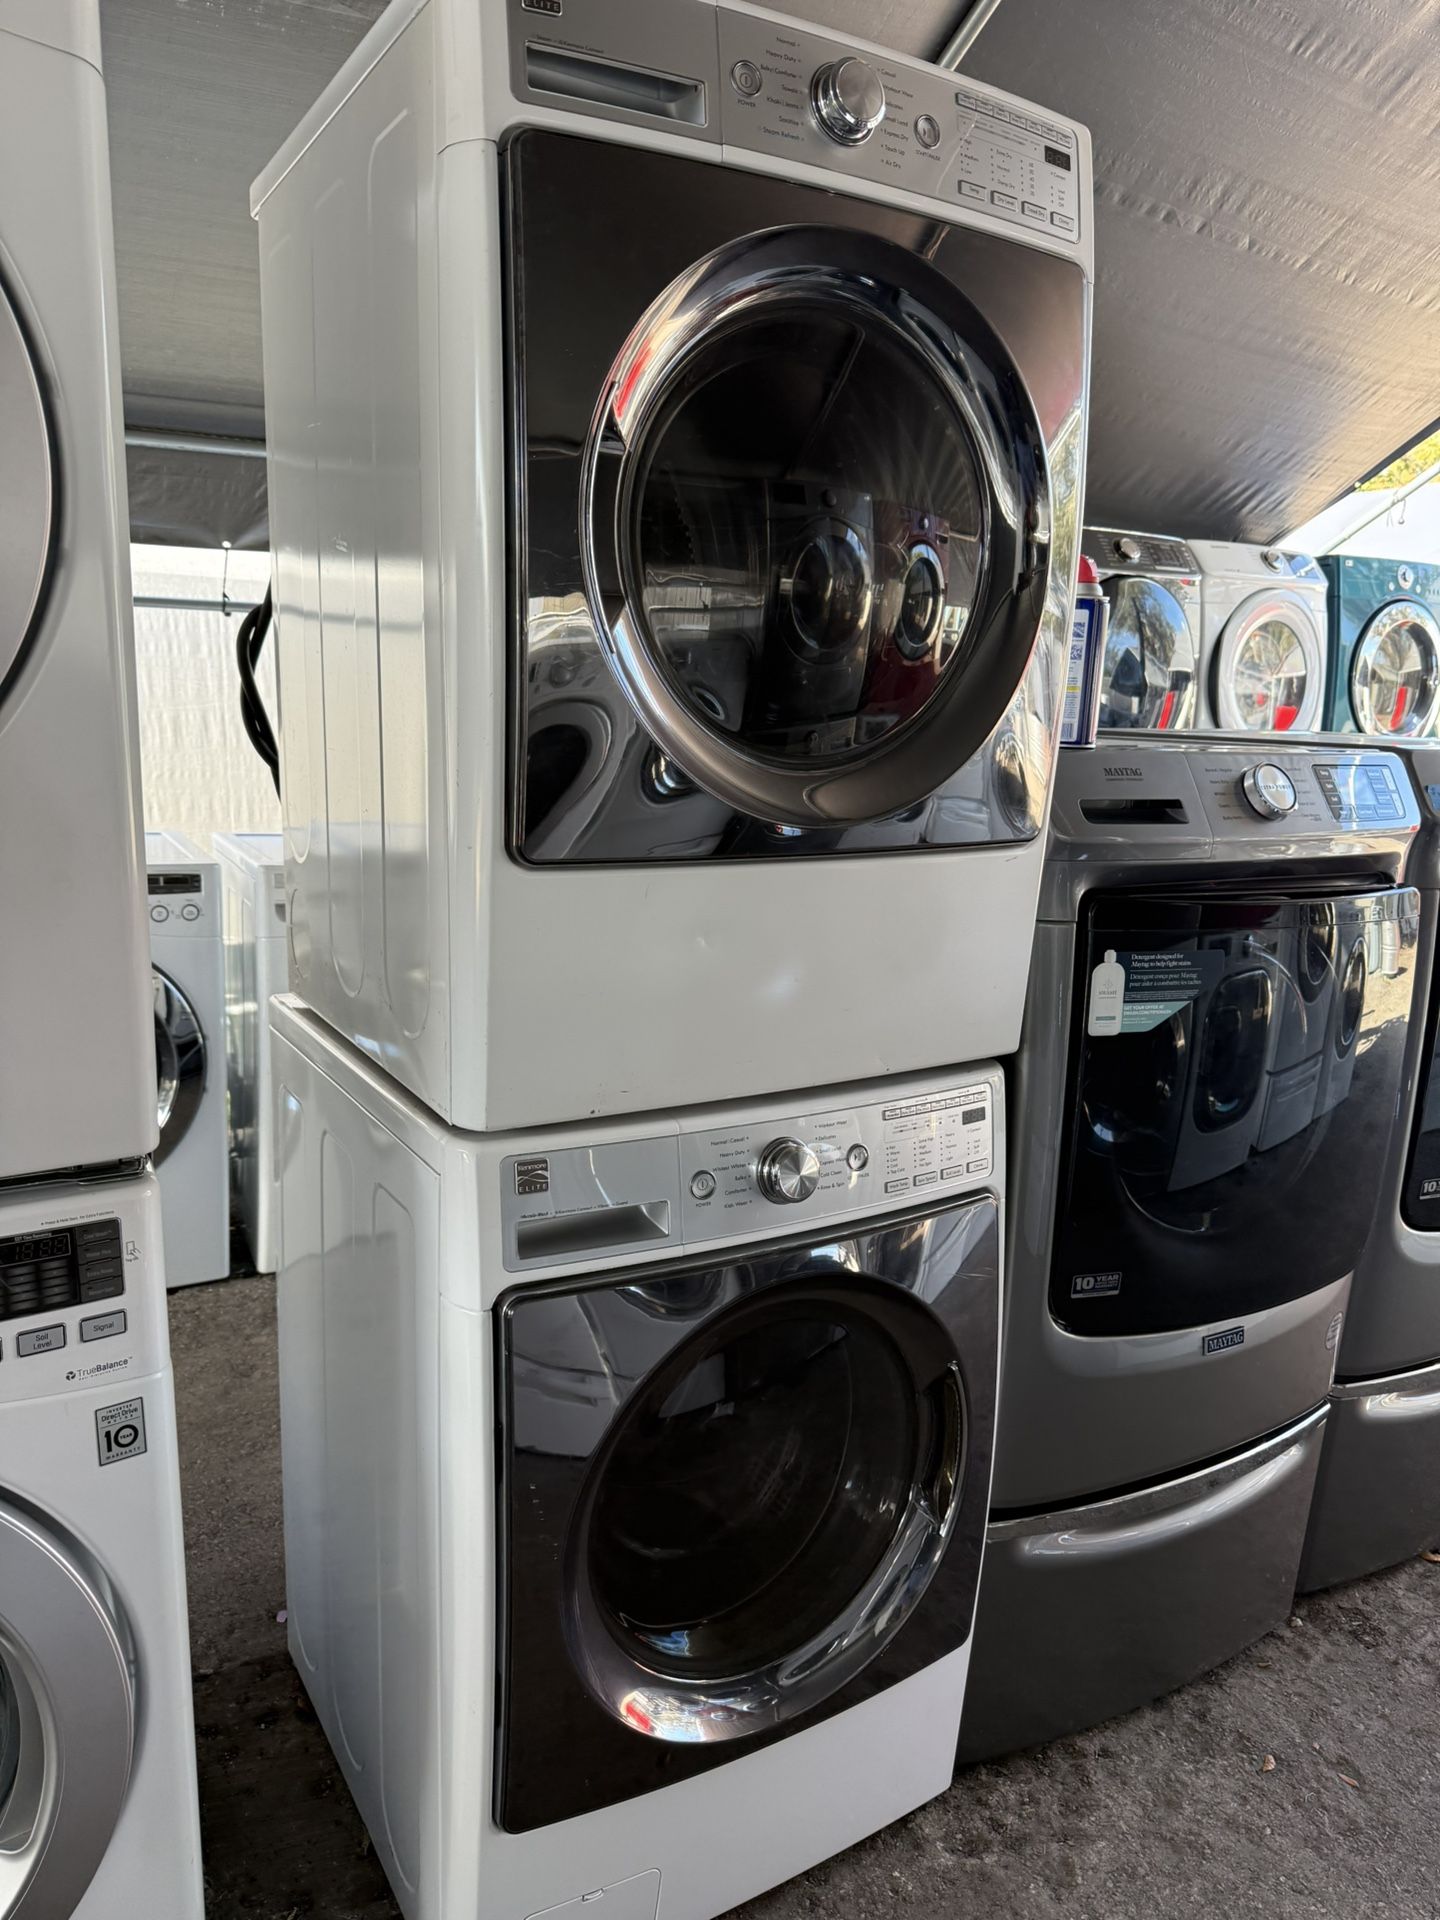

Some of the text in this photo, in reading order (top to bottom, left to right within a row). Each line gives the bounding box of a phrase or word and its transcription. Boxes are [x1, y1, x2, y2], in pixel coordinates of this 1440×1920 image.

[1103, 767, 1143, 777] MAYTAG
[519, 1184, 547, 1192] ELITE
[1422, 1181, 1437, 1194] 10
[1075, 1276, 1095, 1291] 10
[1096, 1274, 1119, 1282] YEAR
[93, 1321, 114, 1333] Signal
[35, 1333, 50, 1342] Soil
[1208, 1331, 1244, 1351] MAYTAG
[33, 1341, 53, 1351] Level
[101, 1406, 139, 1422] Direct Drive
[104, 1423, 140, 1453] 10
[120, 1432, 134, 1440] YEAR
[104, 1446, 142, 1461] WARRANTY
